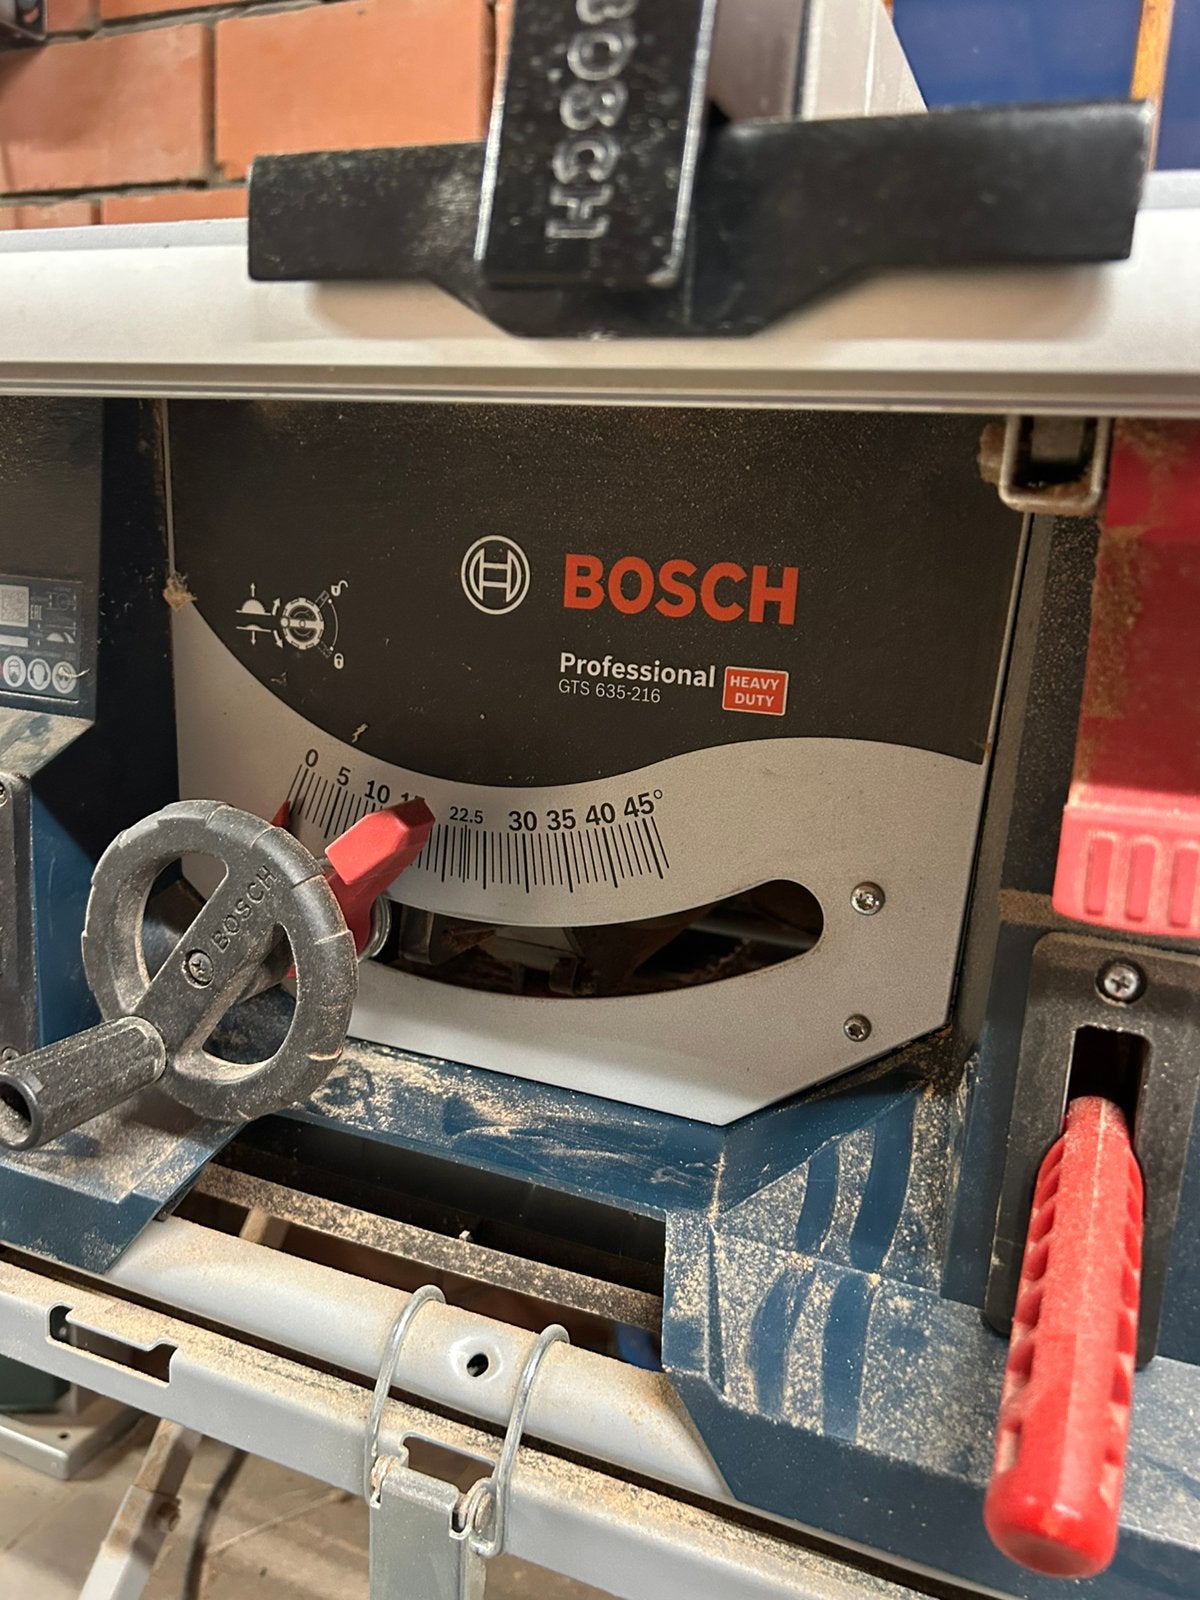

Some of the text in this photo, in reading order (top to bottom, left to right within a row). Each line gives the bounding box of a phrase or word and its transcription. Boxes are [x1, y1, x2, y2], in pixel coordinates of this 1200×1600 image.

[563, 553, 799, 626] BOSCH
[560, 652, 716, 688] Professional
[730, 675, 780, 691] HEAVY
[558, 679, 661, 703] GTS 635-216
[734, 692, 775, 707] DUTY
[305, 749, 319, 767] 0
[337, 766, 351, 786] 5
[364, 780, 391, 804] 10
[449, 806, 484, 824] 22.5
[508, 811, 538, 831] 30
[546, 809, 576, 830] 35
[585, 803, 616, 825] 40
[211, 865, 278, 953] BOSCH
